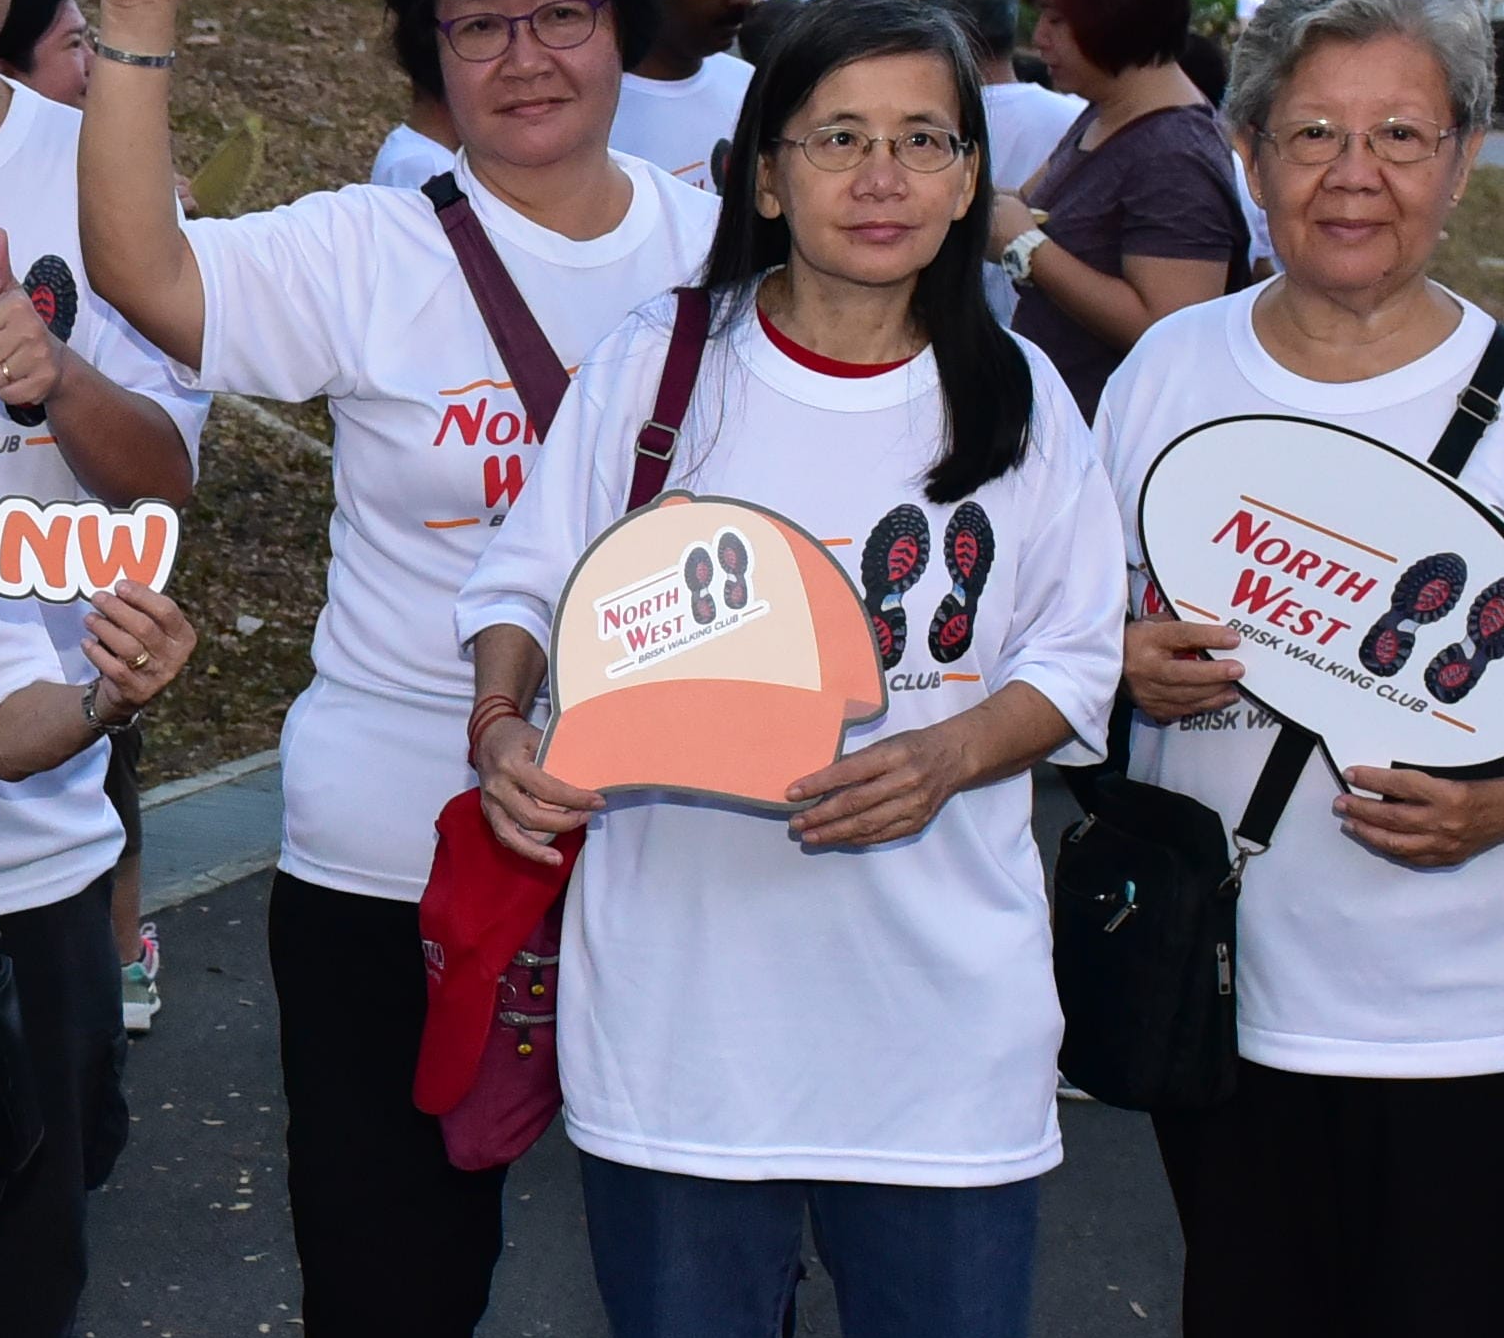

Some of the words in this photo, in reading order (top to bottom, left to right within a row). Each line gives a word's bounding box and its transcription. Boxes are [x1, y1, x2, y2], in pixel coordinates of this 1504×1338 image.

[1211, 509, 1378, 603] NORTH
[603, 586, 679, 634] NORTH
[1231, 567, 1352, 646] WEST
[626, 614, 684, 652] WEST
[669, 626, 713, 652] WALKING
[715, 614, 739, 631] CLUB
[889, 670, 942, 692] CLUB
[1284, 643, 1376, 690] WALKING
[1376, 683, 1429, 714] CLUB
